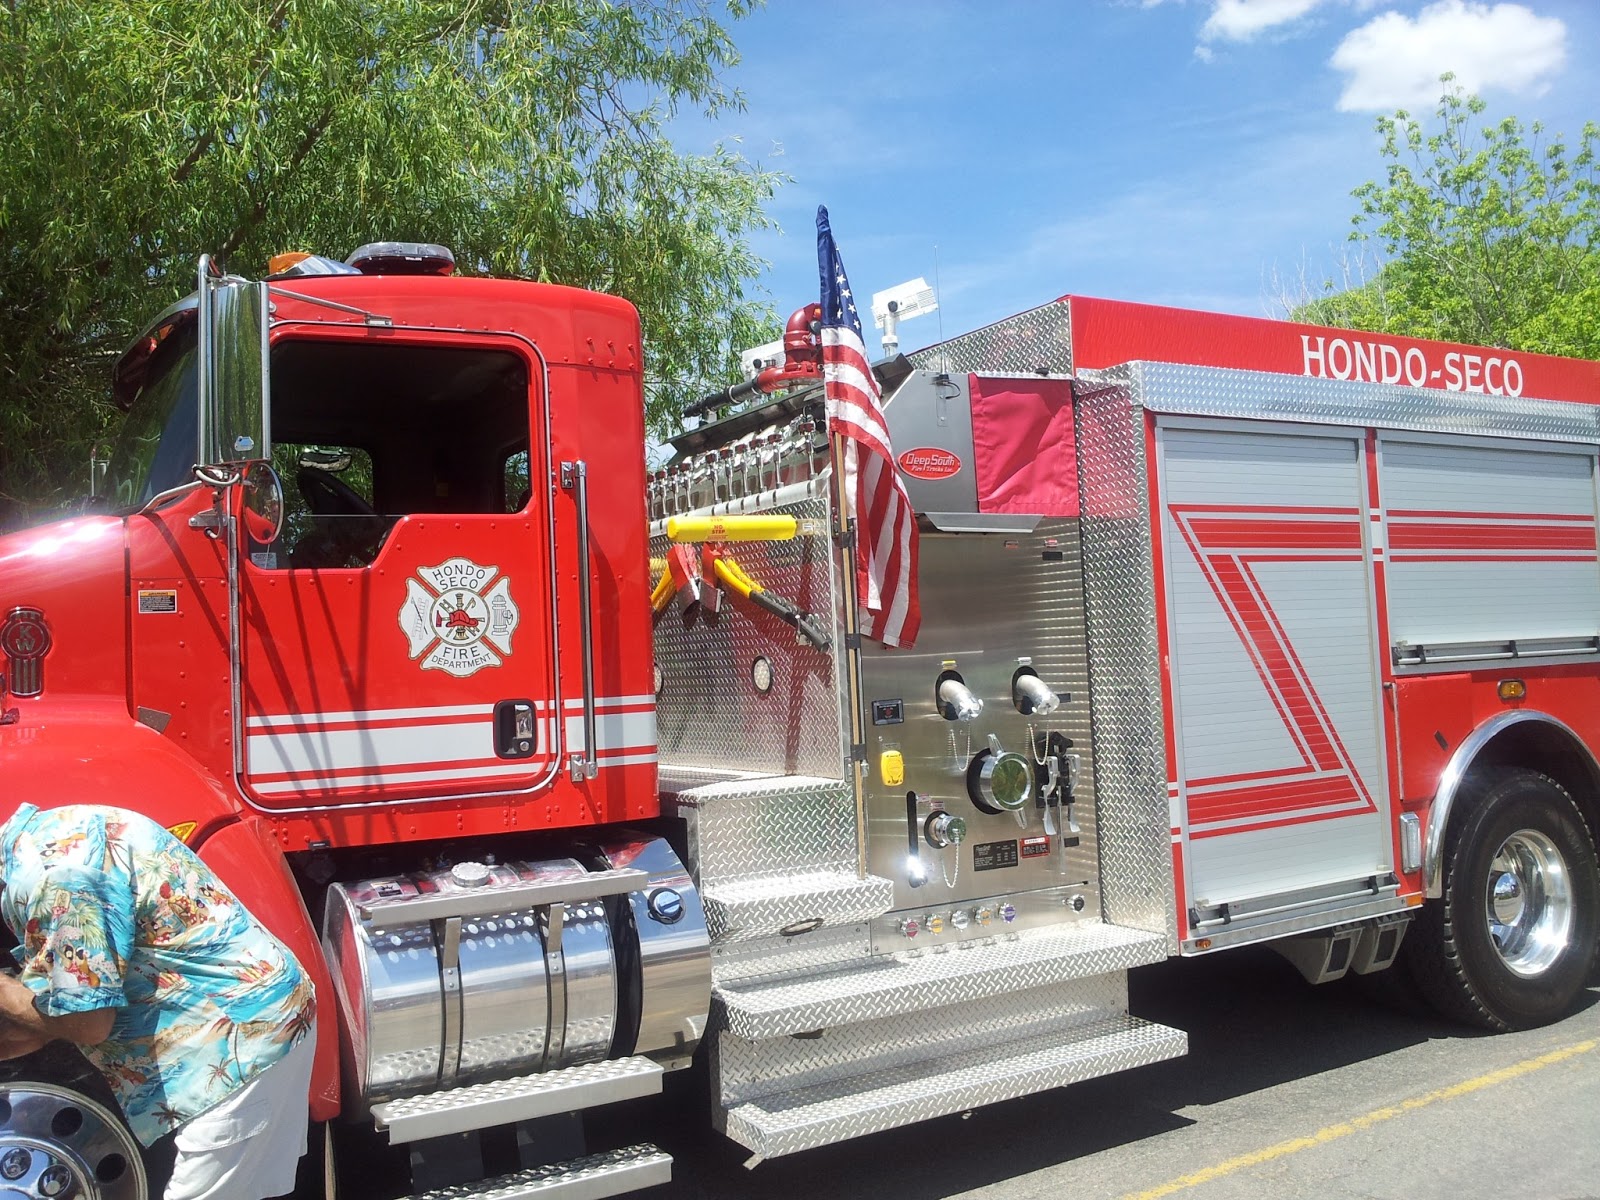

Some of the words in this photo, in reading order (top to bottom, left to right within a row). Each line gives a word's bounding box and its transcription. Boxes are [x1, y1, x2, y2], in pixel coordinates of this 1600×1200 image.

[1300, 335, 1523, 397] HONDO-SECO
[906, 453, 930, 471] Deep
[931, 454, 955, 466] South
[432, 564, 486, 581] HONDO
[439, 576, 479, 590] SECO
[431, 652, 492, 669] DEPARTMENT
[442, 645, 481, 660] FIRE
